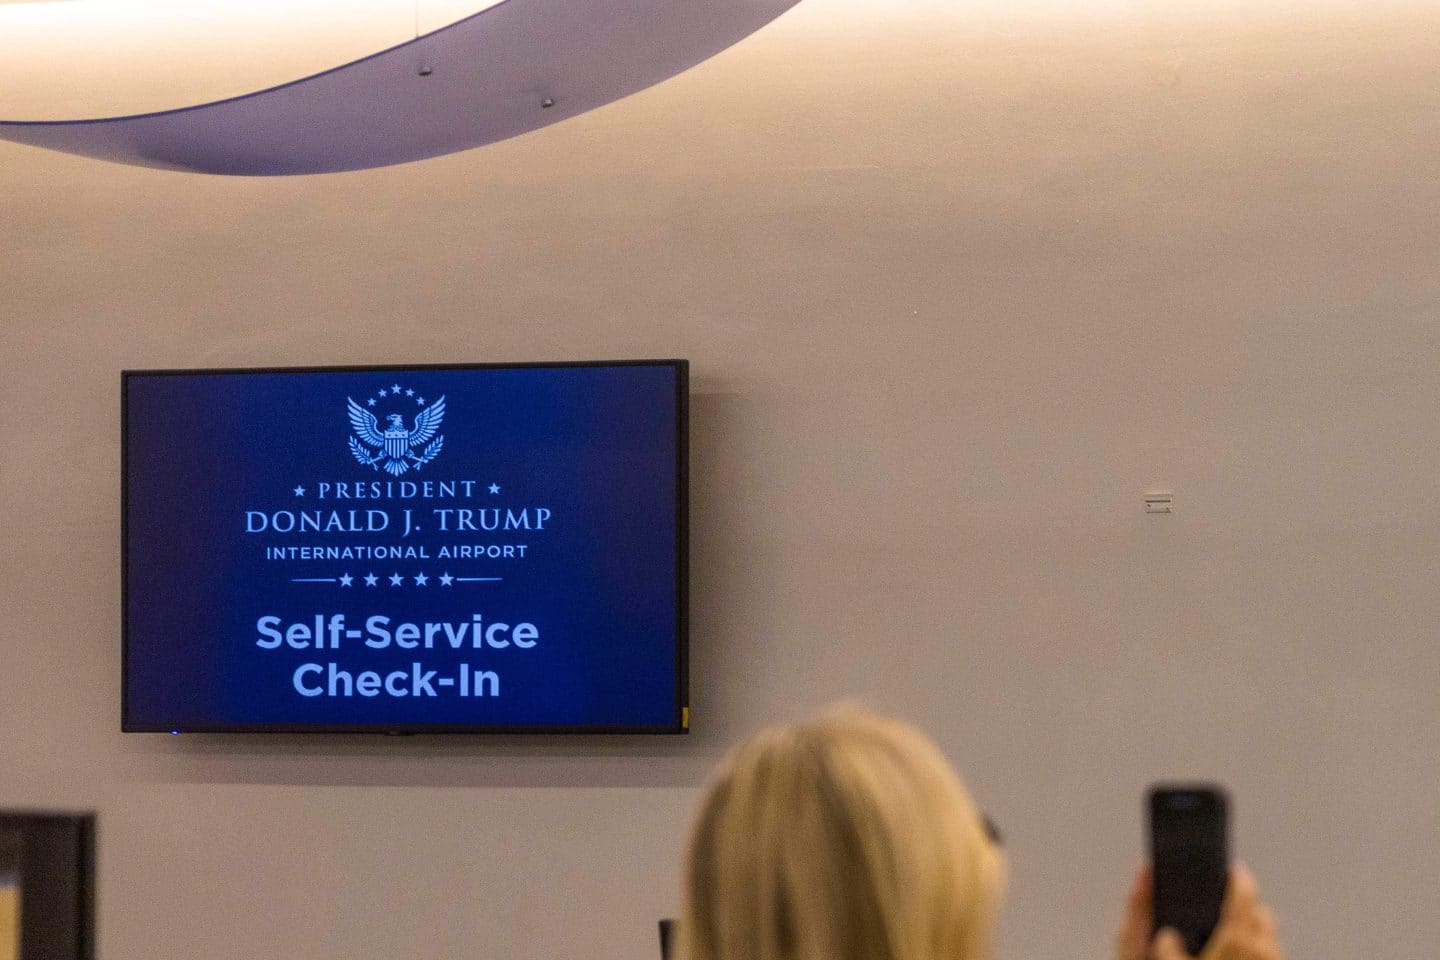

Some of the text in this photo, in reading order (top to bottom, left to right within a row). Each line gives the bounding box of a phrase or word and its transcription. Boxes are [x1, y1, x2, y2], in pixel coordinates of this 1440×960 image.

[319, 480, 476, 499] PRESIDENT
[245, 507, 551, 537] DONALD J. TRUMP
[266, 544, 528, 560] INTERNATIONAL AIRPORT
[255, 613, 539, 650] Self-Service
[292, 662, 500, 697] Check-In
